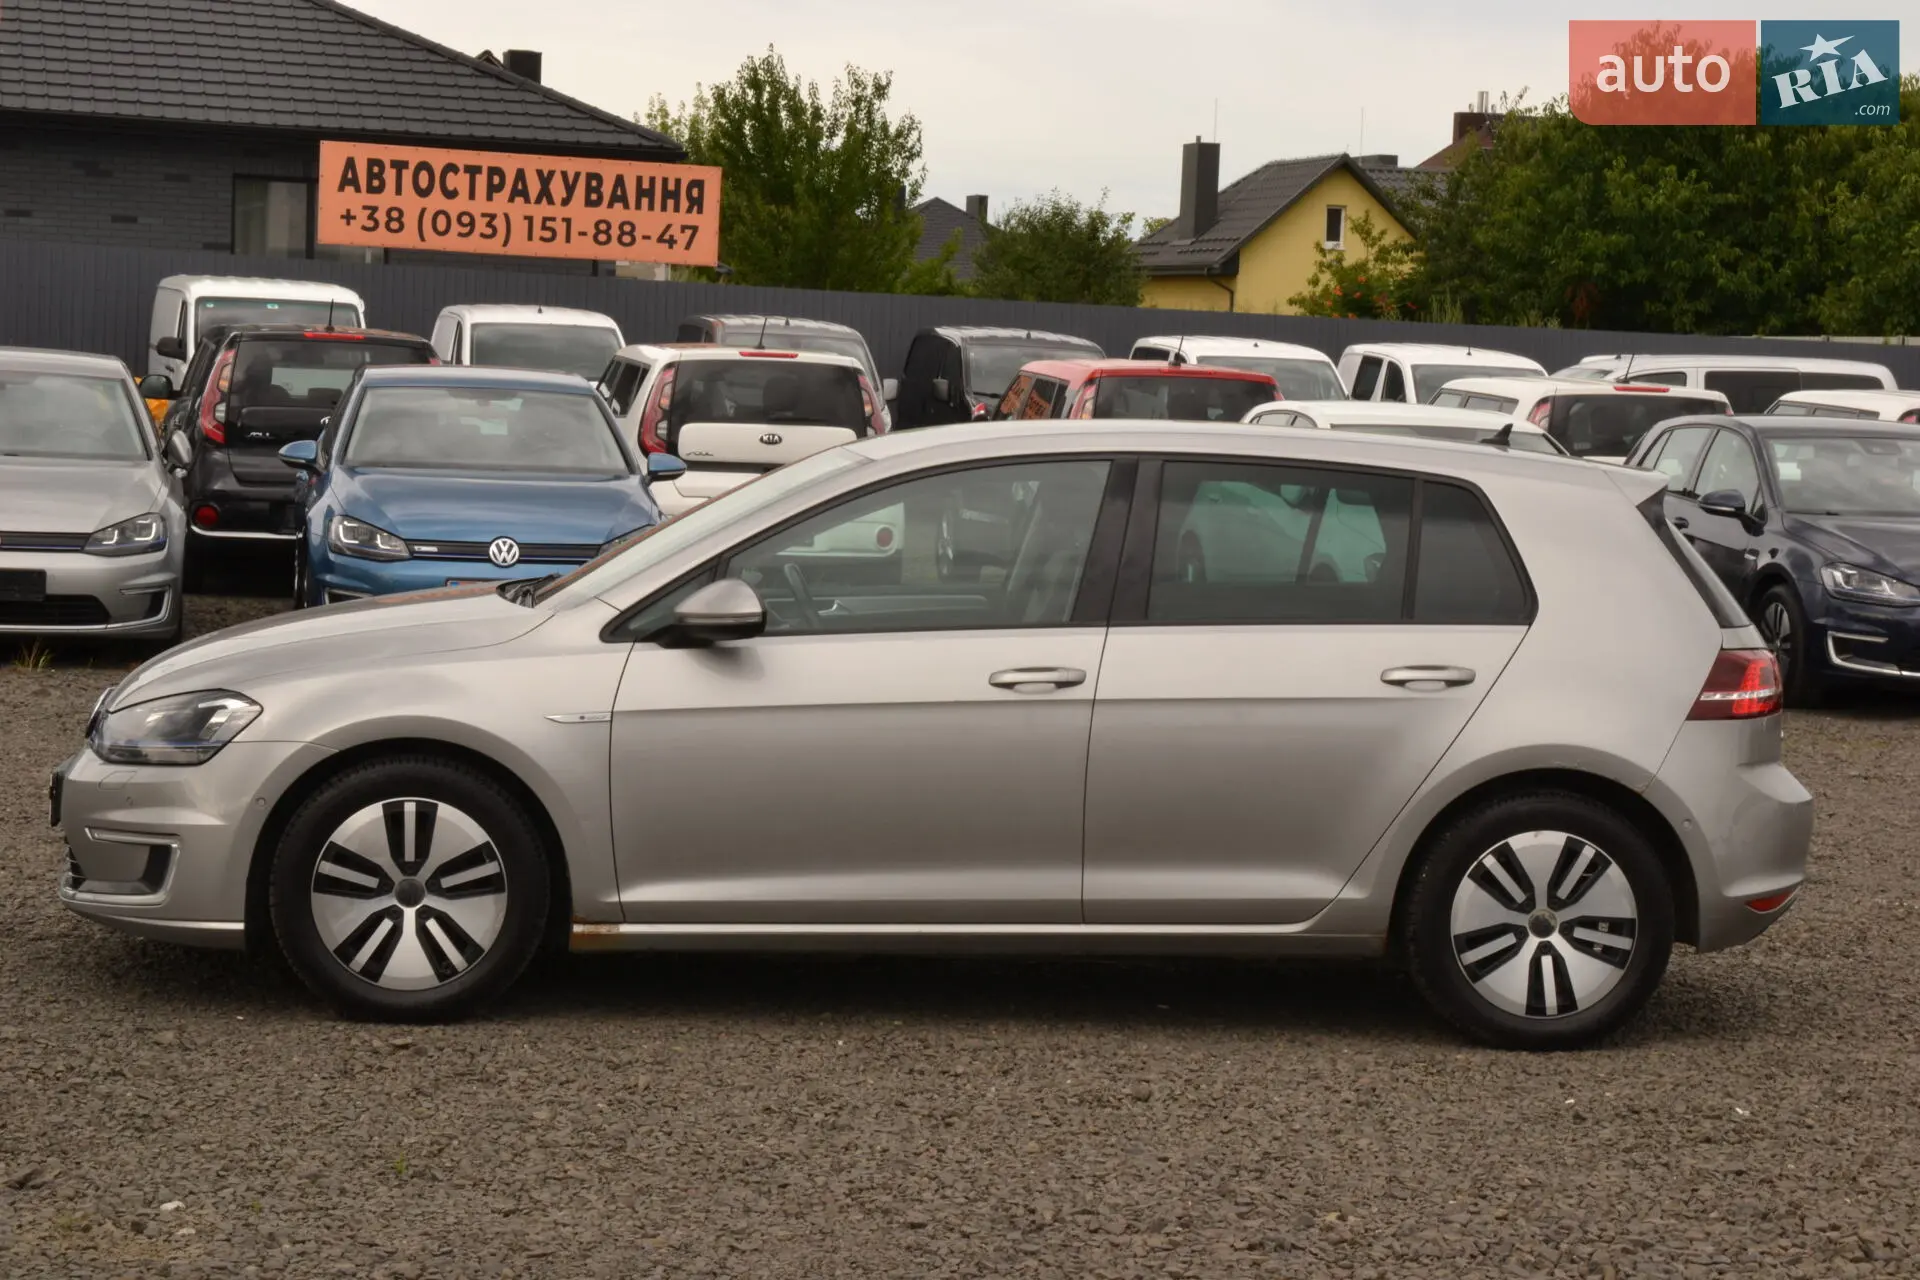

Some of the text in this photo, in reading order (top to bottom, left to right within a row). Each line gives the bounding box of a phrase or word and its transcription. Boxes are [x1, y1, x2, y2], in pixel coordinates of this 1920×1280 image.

[337, 155, 706, 215] АВТОСТРАХУВАННЯ
[339, 205, 700, 252] +38 (093) 151-88-47
[761, 434, 782, 444] KIA
